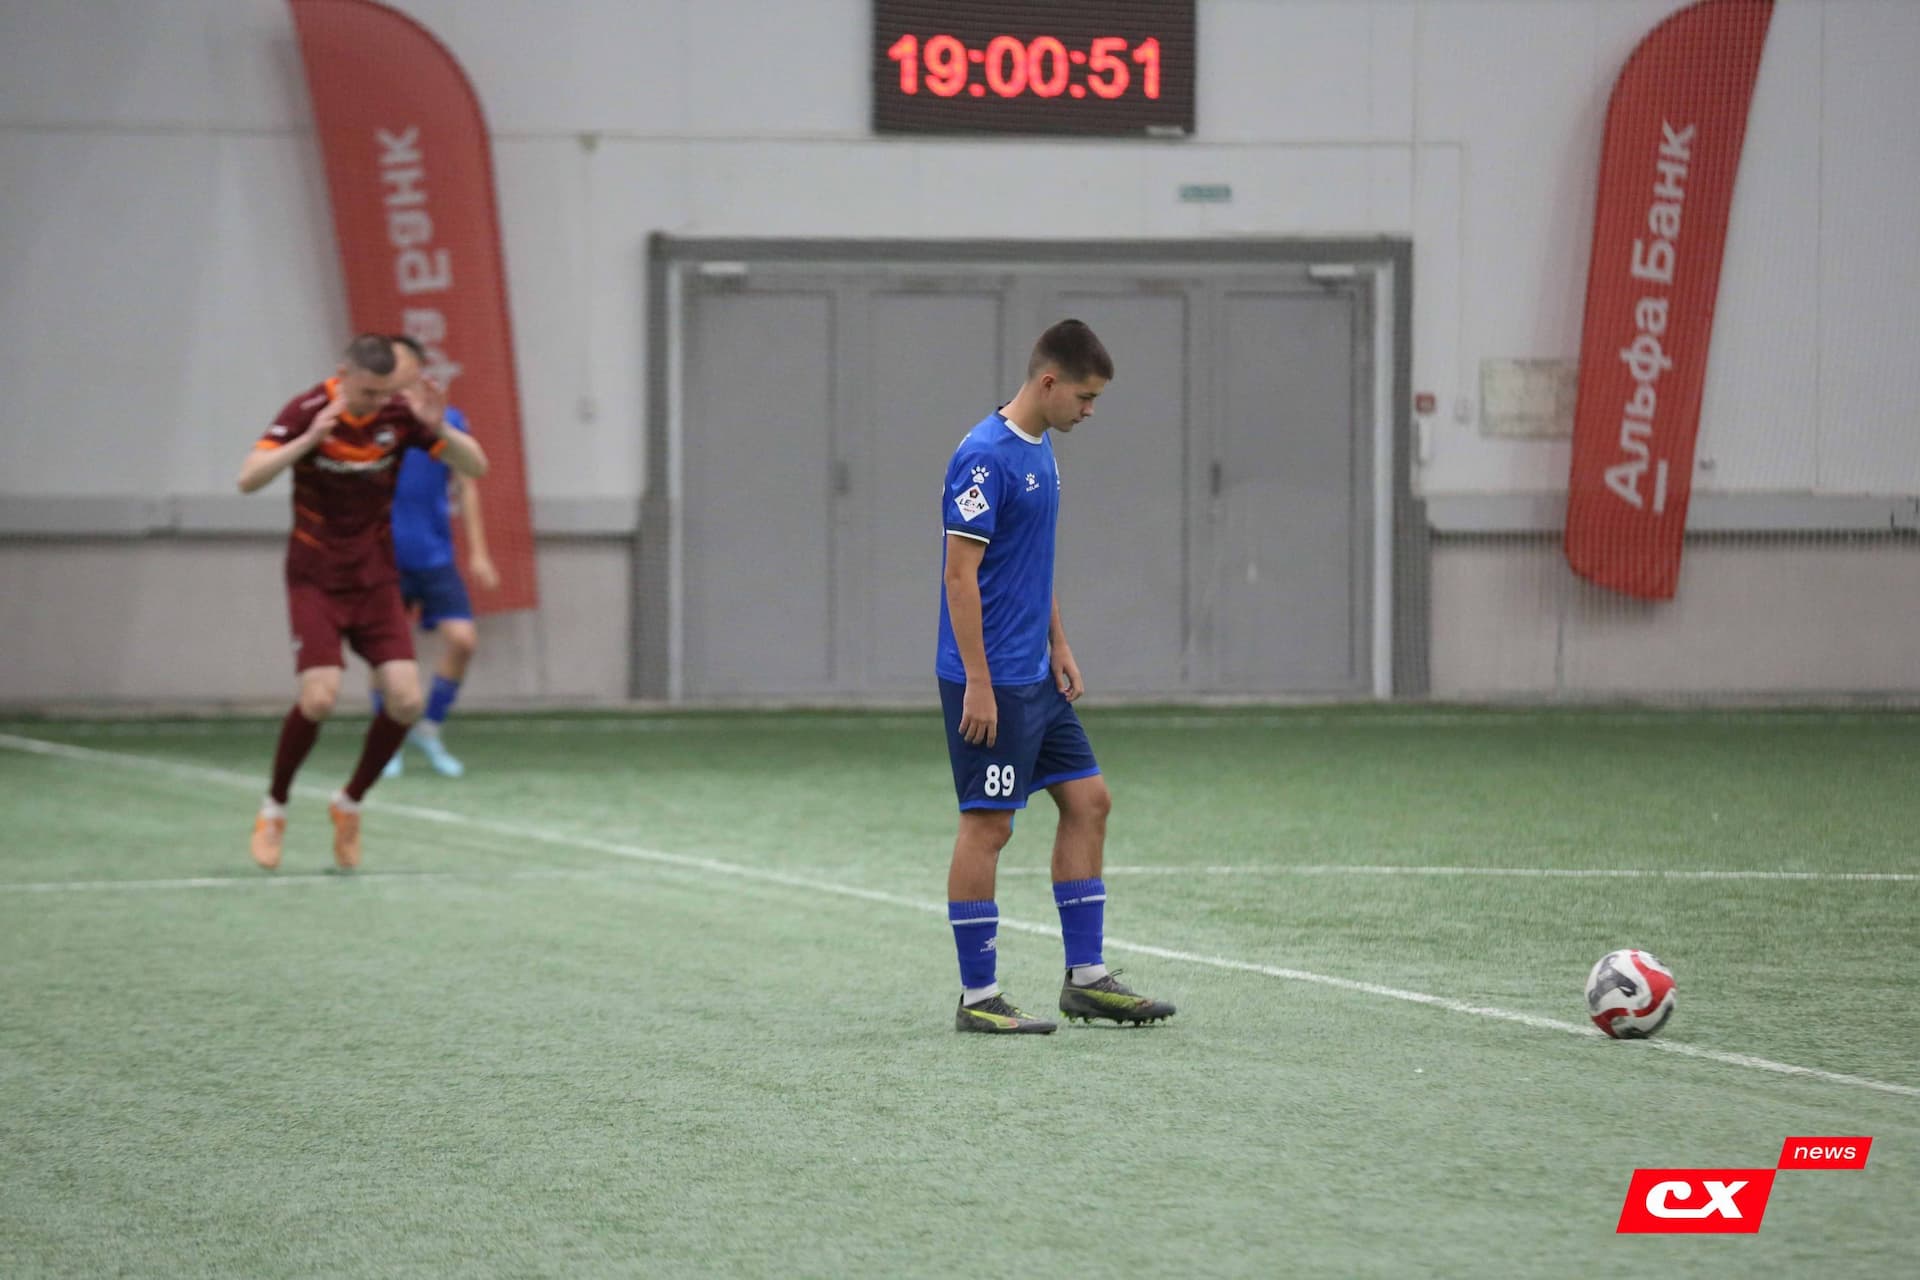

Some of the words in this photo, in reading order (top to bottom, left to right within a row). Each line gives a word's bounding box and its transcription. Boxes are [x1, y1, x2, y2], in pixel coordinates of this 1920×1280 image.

[888, 34, 1160, 99] 19:00:51
[1631, 120, 1695, 286] Банк
[1605, 295, 1672, 509] Альфа
[959, 498, 985, 510] LEN
[984, 764, 1015, 797] 89
